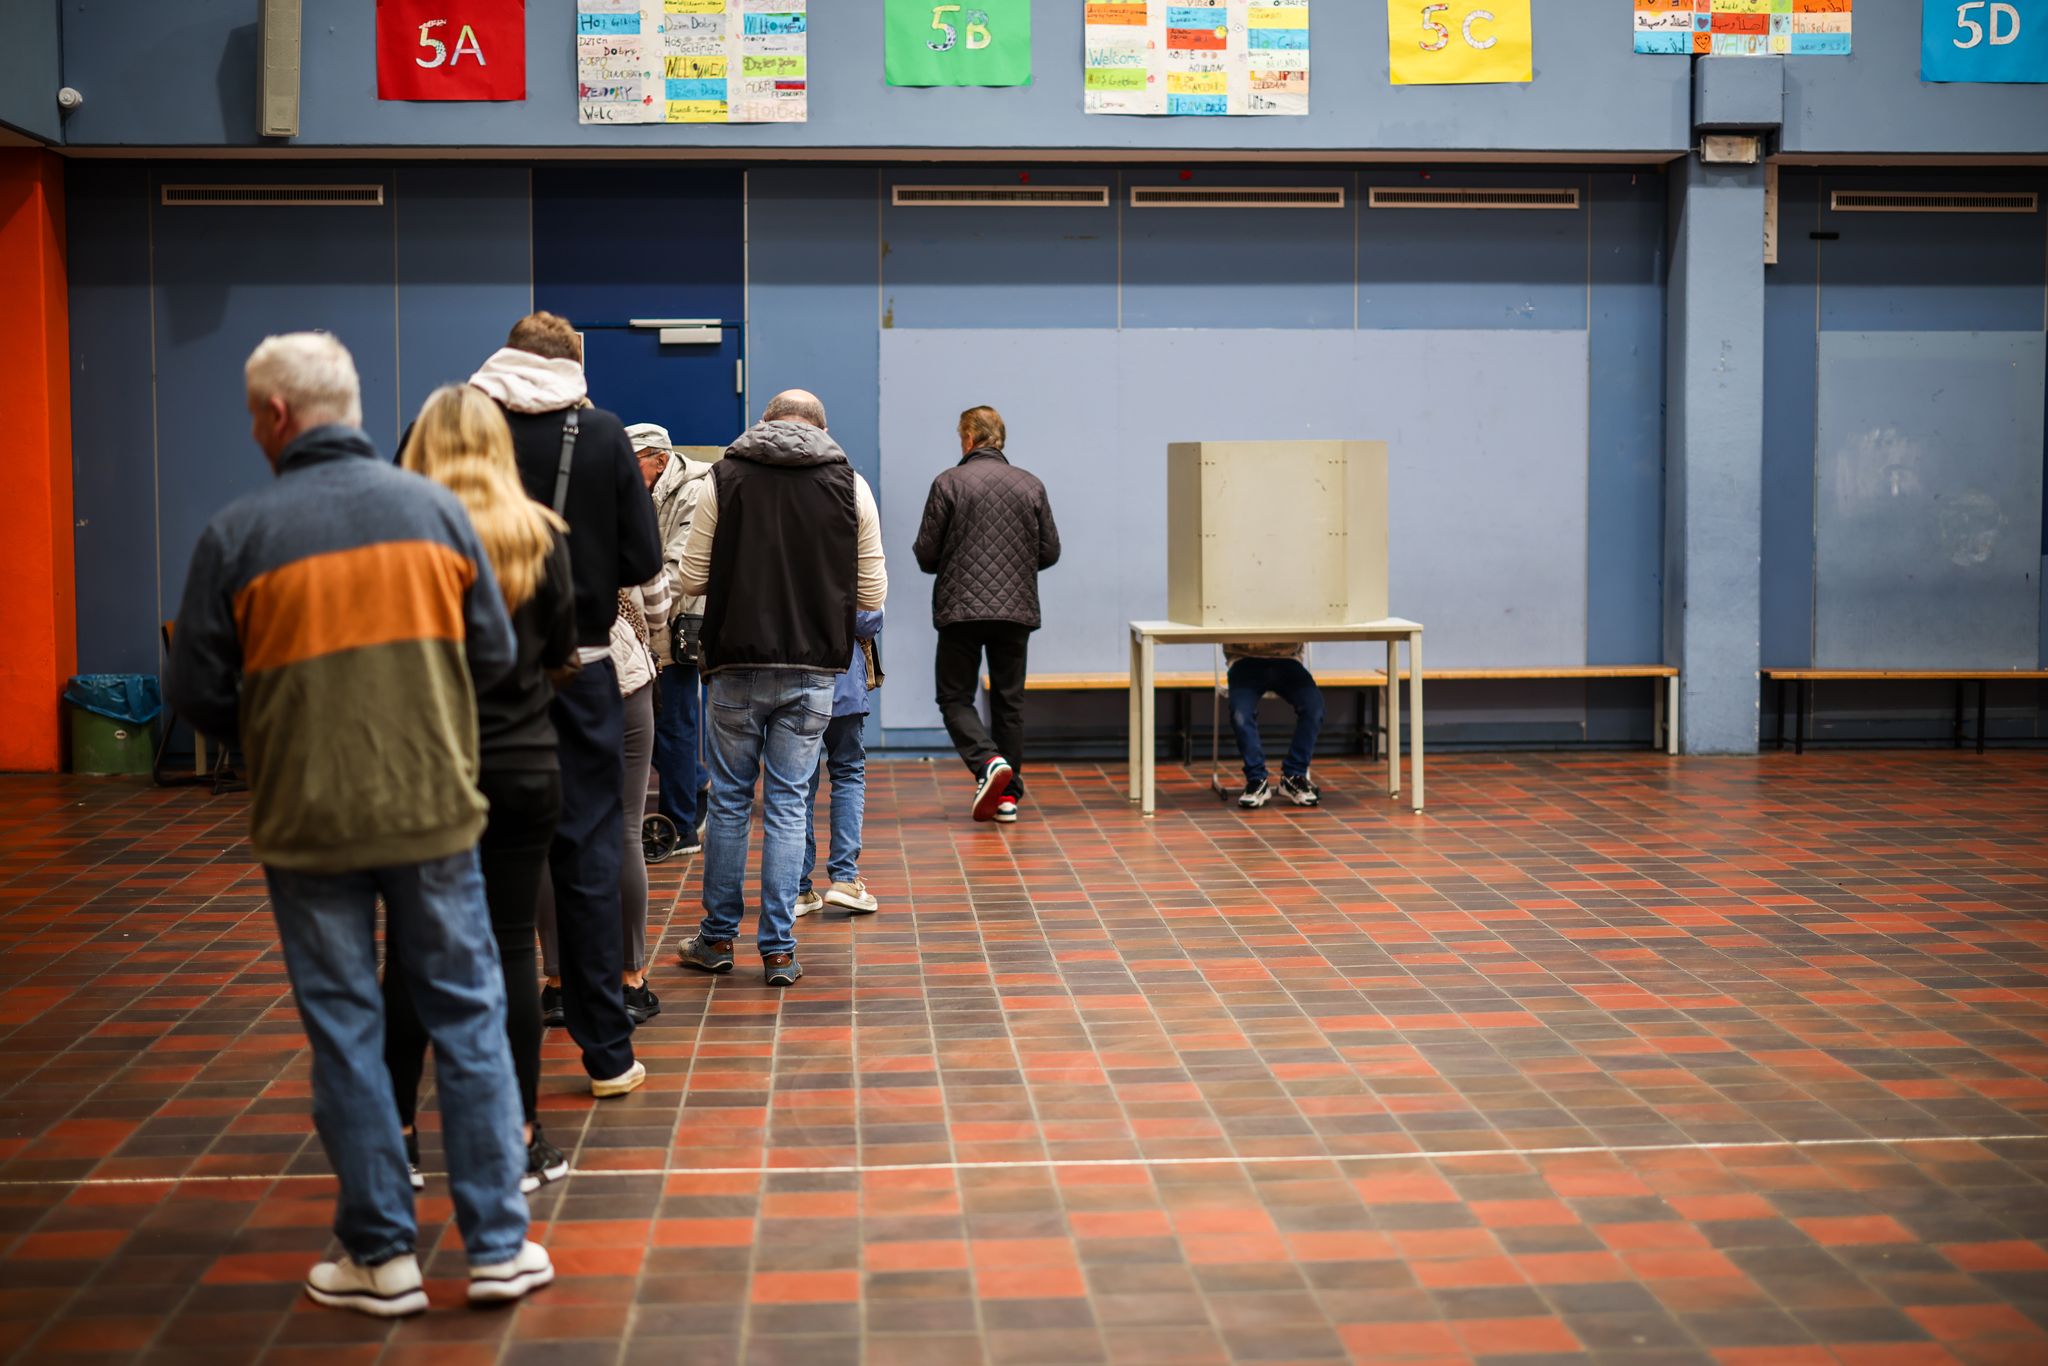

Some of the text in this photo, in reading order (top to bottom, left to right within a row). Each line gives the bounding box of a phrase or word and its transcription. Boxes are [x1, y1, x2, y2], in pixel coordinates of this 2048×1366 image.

[416, 19, 486, 68] 5A
[927, 5, 992, 52] 5B
[1419, 3, 1498, 52] 5C
[1953, 1, 2020, 48] 5D
